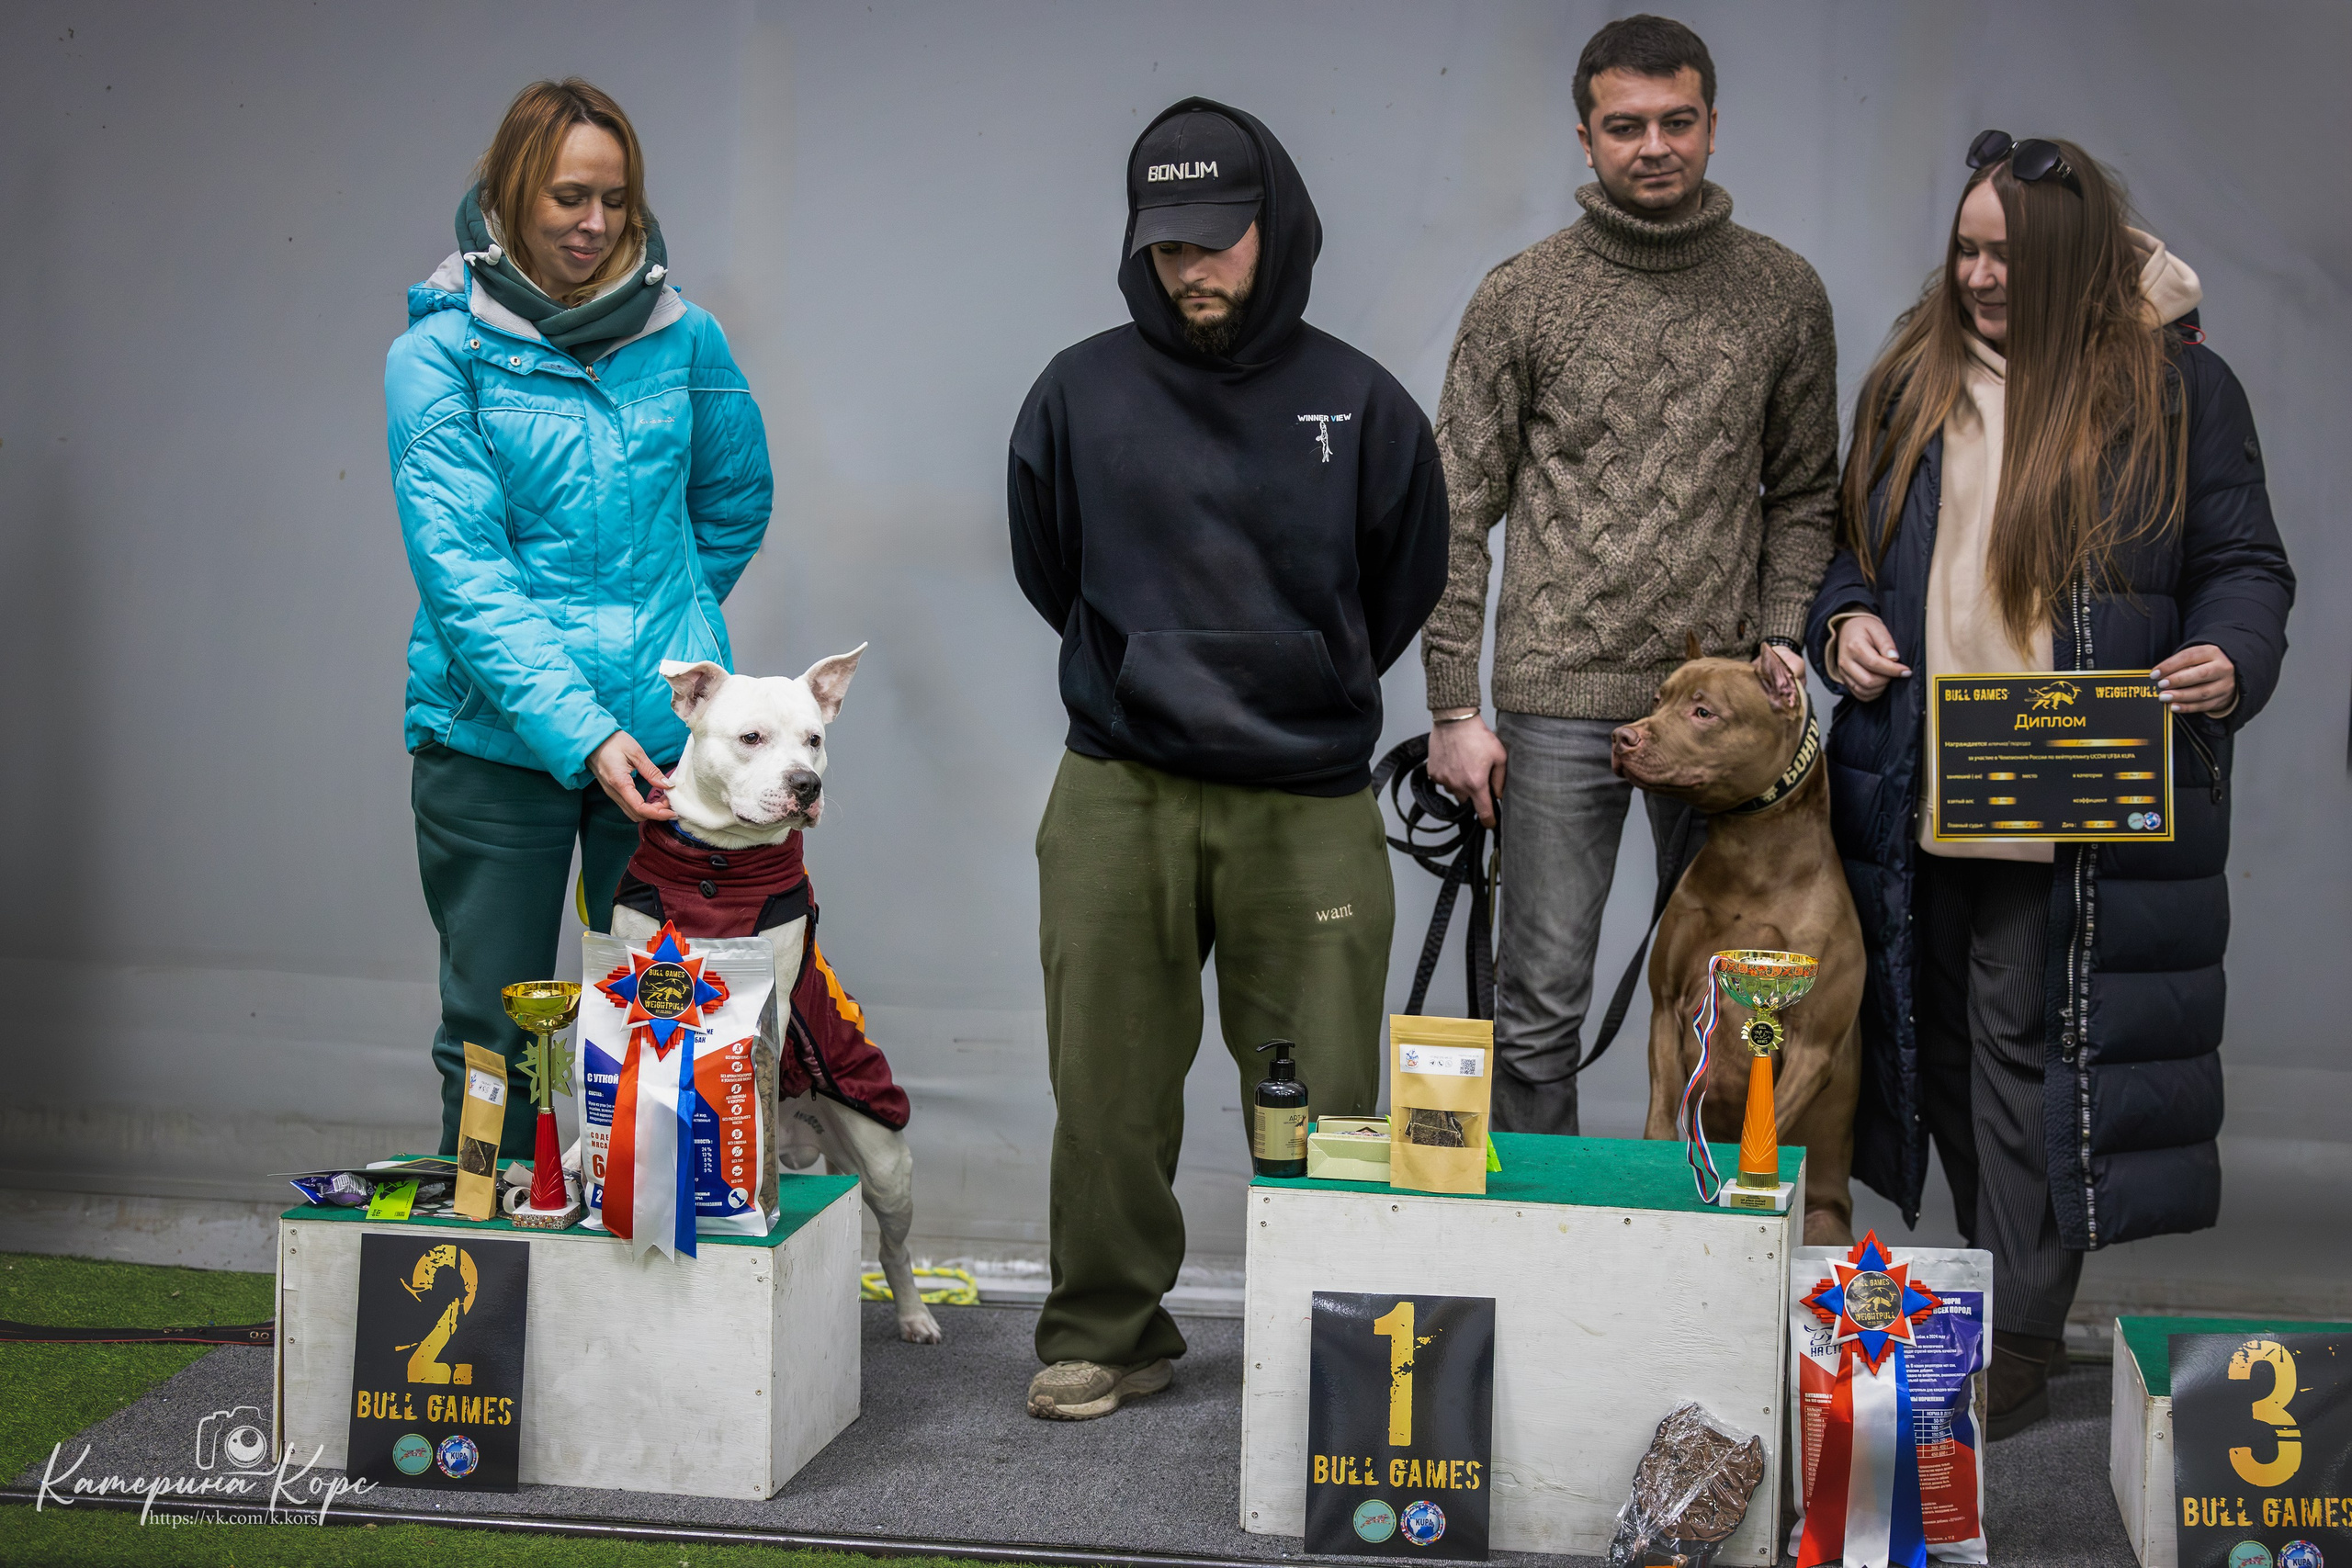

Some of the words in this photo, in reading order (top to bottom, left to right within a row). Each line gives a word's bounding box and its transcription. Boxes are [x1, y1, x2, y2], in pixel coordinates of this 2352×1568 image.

[1148, 161, 1218, 182] BONUM
[1330, 413, 1351, 422] VIEW
[1945, 689, 1971, 702] BULL
[1973, 688, 2008, 701] GAMES
[2095, 686, 2159, 699] WEIGHTPULL
[2014, 714, 2086, 730] Диплом
[1316, 903, 1353, 922] want
[665, 970, 685, 978] GAMES
[645, 1000, 684, 1010] WEIGHTPULL
[587, 1073, 593, 1082] С
[594, 1073, 619, 1084] УТКОЙ
[591, 1132, 609, 1141] СОДЕ
[592, 1141, 608, 1149] МЯСА
[593, 1154, 605, 1179] 6
[1870, 1278, 1890, 1286] GAMES
[404, 1244, 479, 1384] 2
[1855, 1311, 1895, 1321] WEIGHTPULL
[1950, 1306, 1972, 1315] ПОРОД
[1811, 1347, 1824, 1357] НА
[1374, 1301, 1415, 1446] 1
[356, 1390, 418, 1420] BULL
[427, 1394, 514, 1425] GAMES
[2228, 1339, 2302, 1487] 3
[450, 1452, 468, 1461] KUPA
[1313, 1454, 1379, 1485] BULL
[1389, 1459, 1483, 1490] GAMES
[2183, 1496, 2253, 1527] BULL
[1415, 1518, 1434, 1527] KUPA
